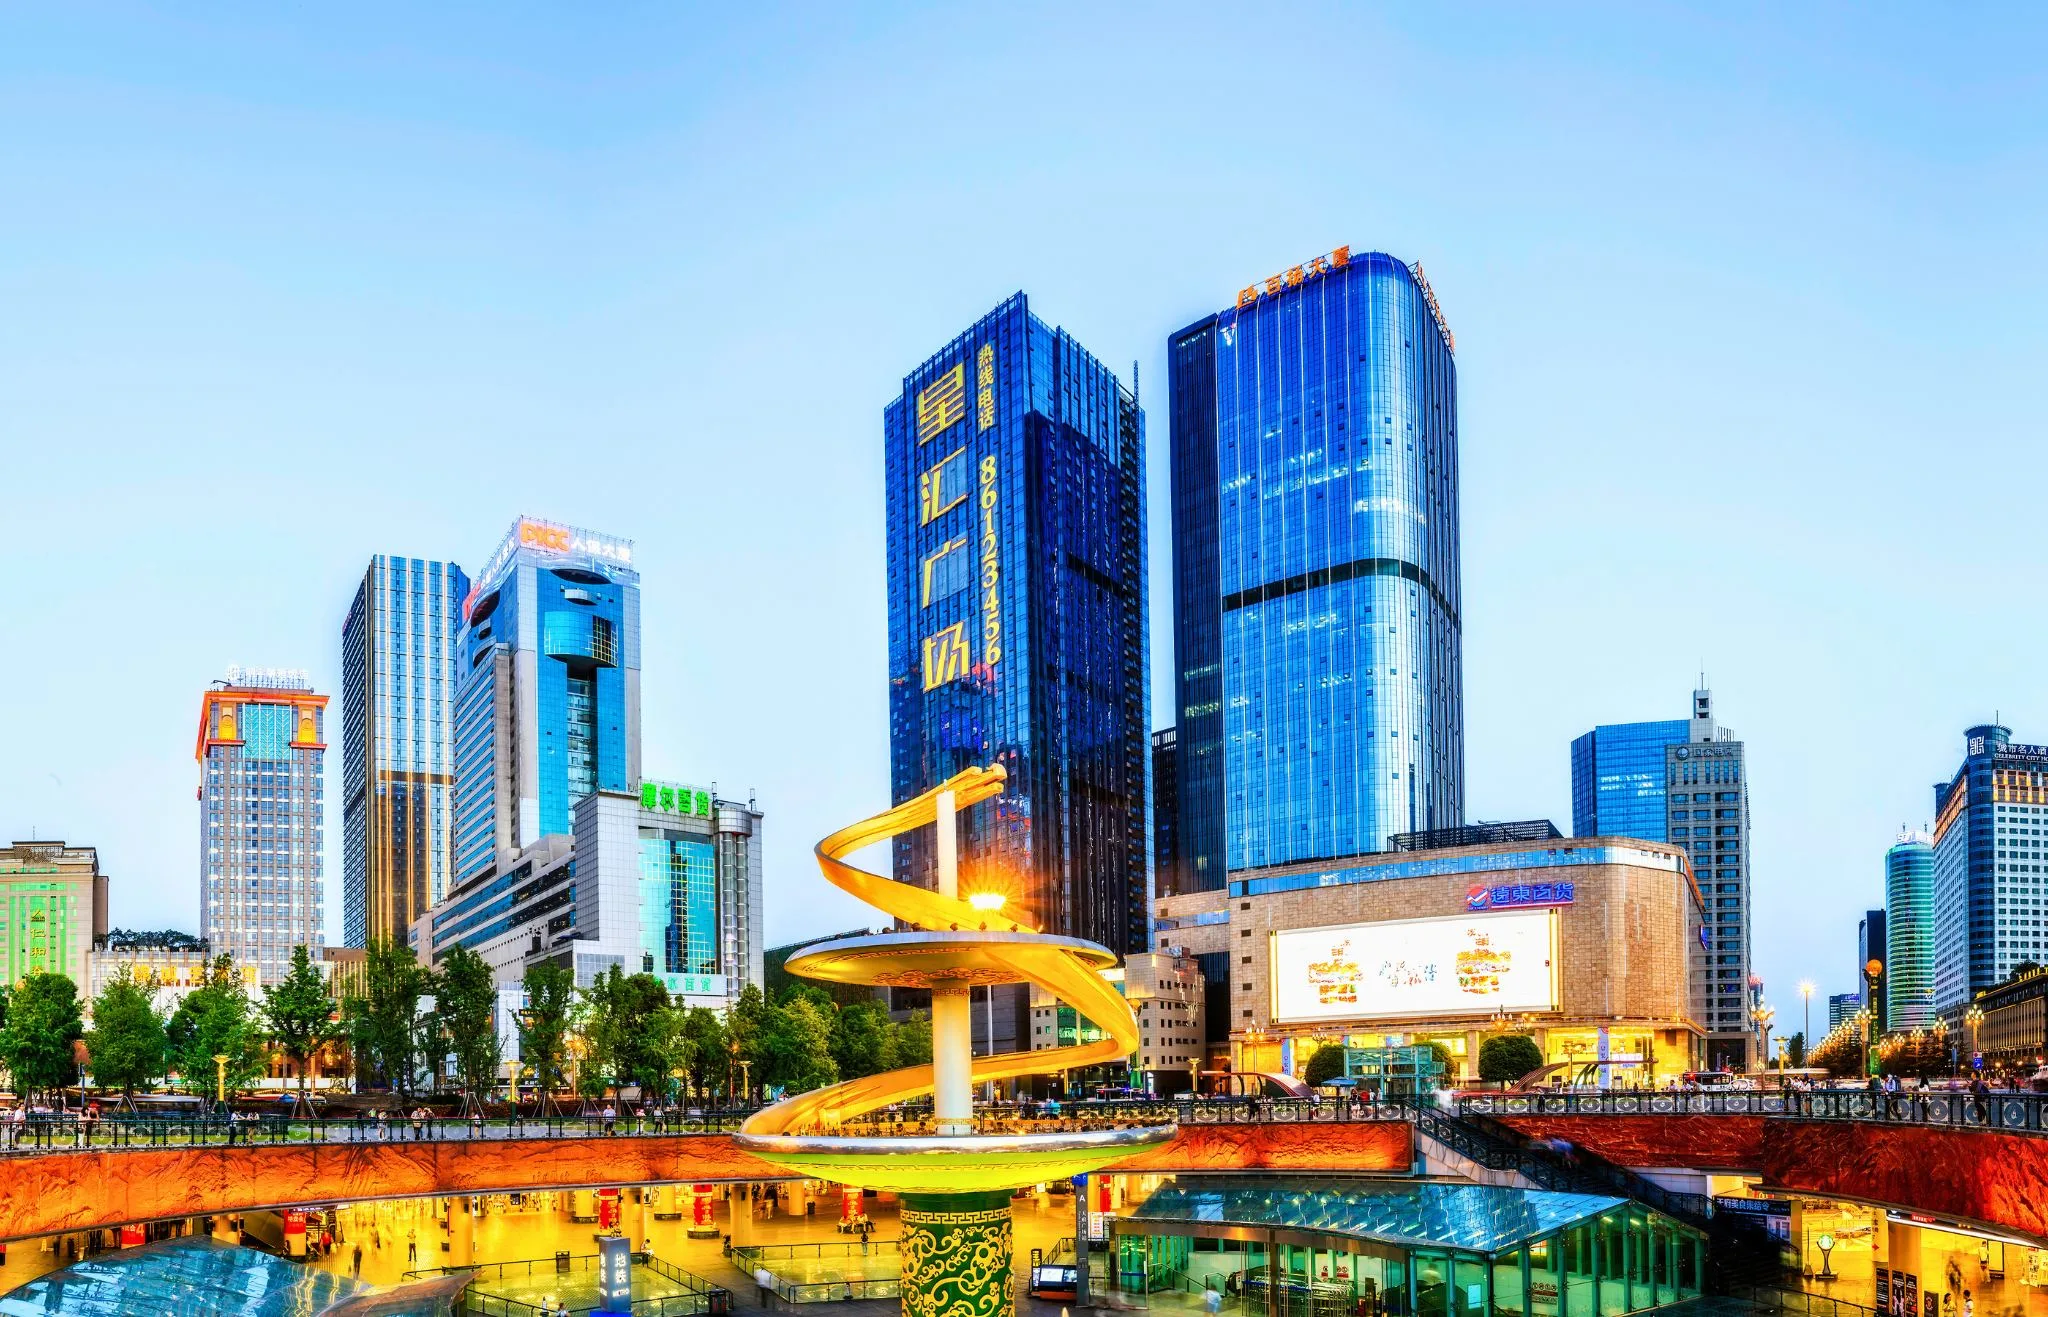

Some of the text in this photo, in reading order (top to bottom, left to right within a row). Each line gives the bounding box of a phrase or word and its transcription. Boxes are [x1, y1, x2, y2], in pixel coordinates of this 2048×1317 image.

[520, 522, 570, 552] PICC
[918, 362, 970, 693] 星汇广场
[976, 342, 1001, 666] 热线电话 86123456
[1079, 1194, 1086, 1202] A
